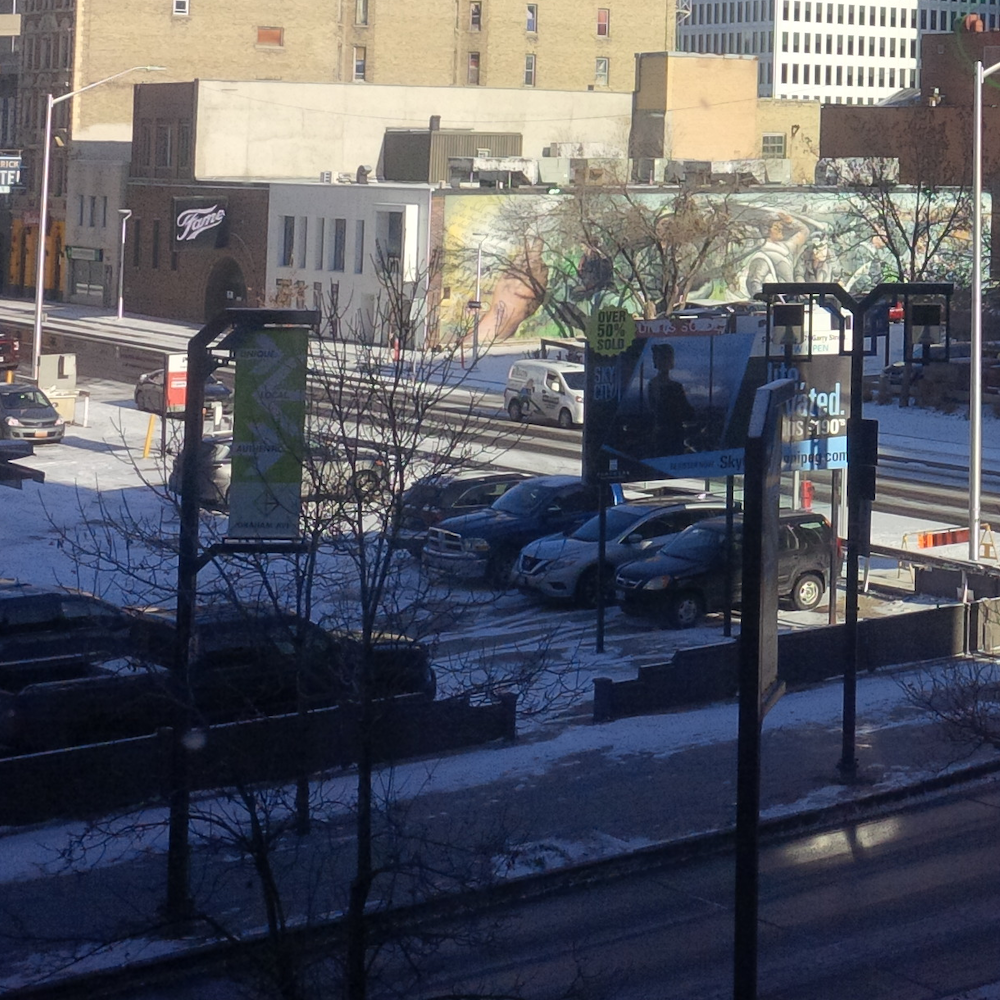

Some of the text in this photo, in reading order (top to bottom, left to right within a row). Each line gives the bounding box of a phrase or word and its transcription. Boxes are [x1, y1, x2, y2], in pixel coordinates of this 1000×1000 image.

[177, 205, 226, 240] Fame
[598, 311, 626, 323] OVER
[597, 325, 625, 338] 50%
[597, 338, 625, 350] SOLD
[594, 366, 615, 384] SKY
